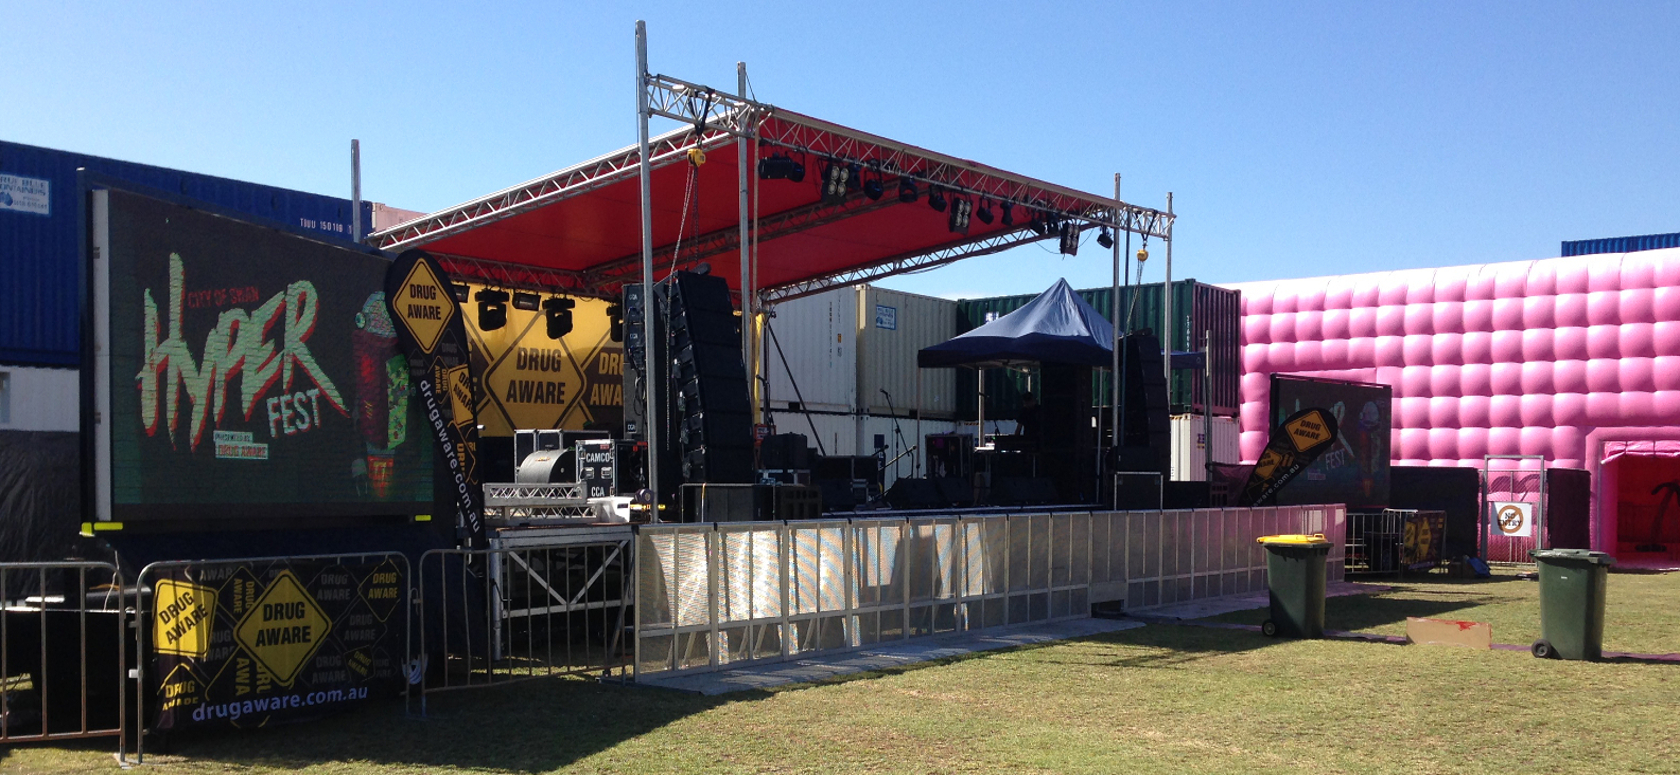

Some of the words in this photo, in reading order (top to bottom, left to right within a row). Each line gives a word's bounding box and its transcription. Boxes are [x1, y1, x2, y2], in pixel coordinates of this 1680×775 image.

[187, 290, 212, 309] CITY
[214, 288, 227, 307] OF
[229, 286, 260, 305] SWAN
[410, 284, 436, 300] DRUG
[407, 304, 441, 320] AWARE
[135, 252, 350, 453] HYPER
[515, 347, 562, 373] DRUG
[598, 352, 624, 376] DRU
[505, 379, 566, 405] AWARE
[589, 383, 624, 406] AWA
[266, 388, 320, 439] FEST
[1293, 427, 1321, 440] AWARE
[1300, 419, 1322, 431] DRUG
[420, 380, 481, 533] drugaware.com.au
[585, 452, 611, 463] CAMCO
[1325, 448, 1345, 471] FEST
[591, 486, 605, 497] CCA
[1504, 512, 1516, 520] NO
[321, 573, 349, 586] DRUG
[373, 572, 397, 585] DRUG
[233, 578, 243, 614] AWARE
[317, 588, 351, 600] AWARE
[368, 587, 398, 600] AWARE
[159, 591, 195, 626] DRUG
[263, 602, 305, 622] DRUG
[165, 603, 209, 645] AWARE
[350, 614, 373, 627] DRUG
[255, 625, 312, 648] AWARE
[344, 629, 376, 642] AWARE
[315, 655, 342, 669] DRUG
[353, 651, 372, 667] DRUG
[311, 674, 346, 685] AWARE
[165, 680, 195, 698] DRUG
[192, 686, 368, 722] drugaware.com.au
